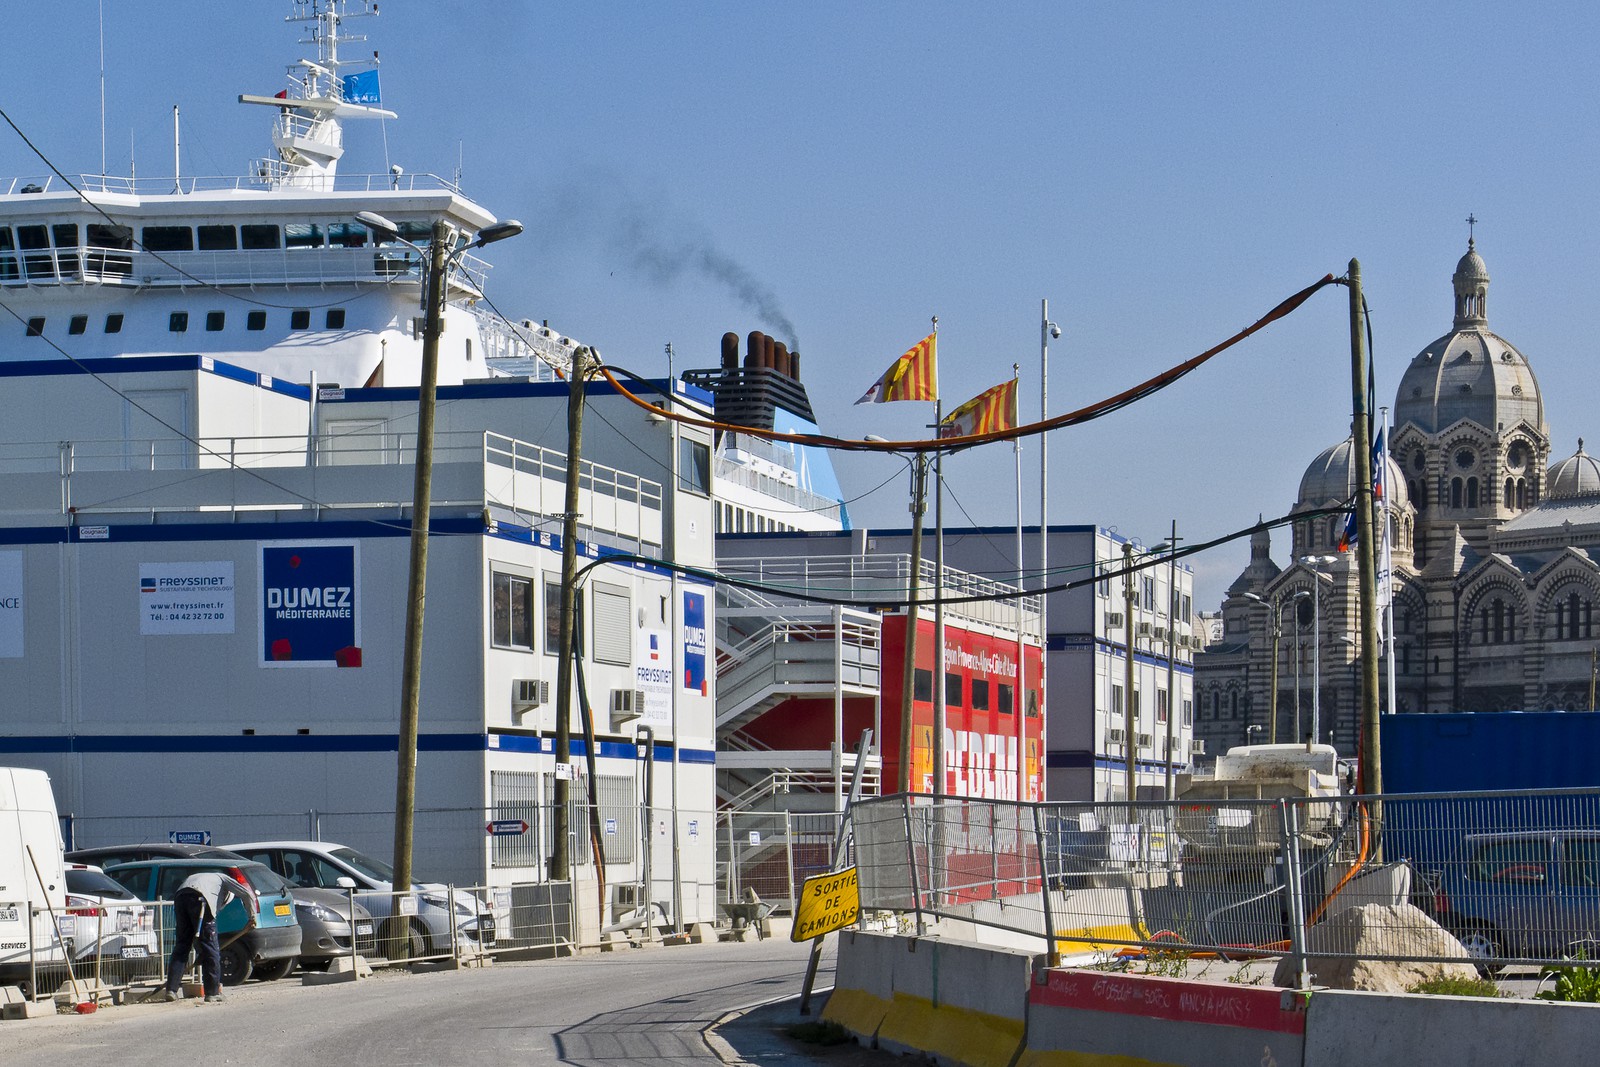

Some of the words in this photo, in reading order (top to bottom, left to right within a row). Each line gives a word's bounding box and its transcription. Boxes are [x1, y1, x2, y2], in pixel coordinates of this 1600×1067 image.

[159, 577, 225, 586] FREYSSINET
[267, 587, 351, 608] DUMEZ
[150, 602, 224, 610] www.freyssinet.fr
[276, 607, 351, 619] MÉDITERRANÉE
[814, 873, 857, 897] SORTIE
[825, 895, 841, 911] DE
[800, 906, 855, 934] CAMIONS
